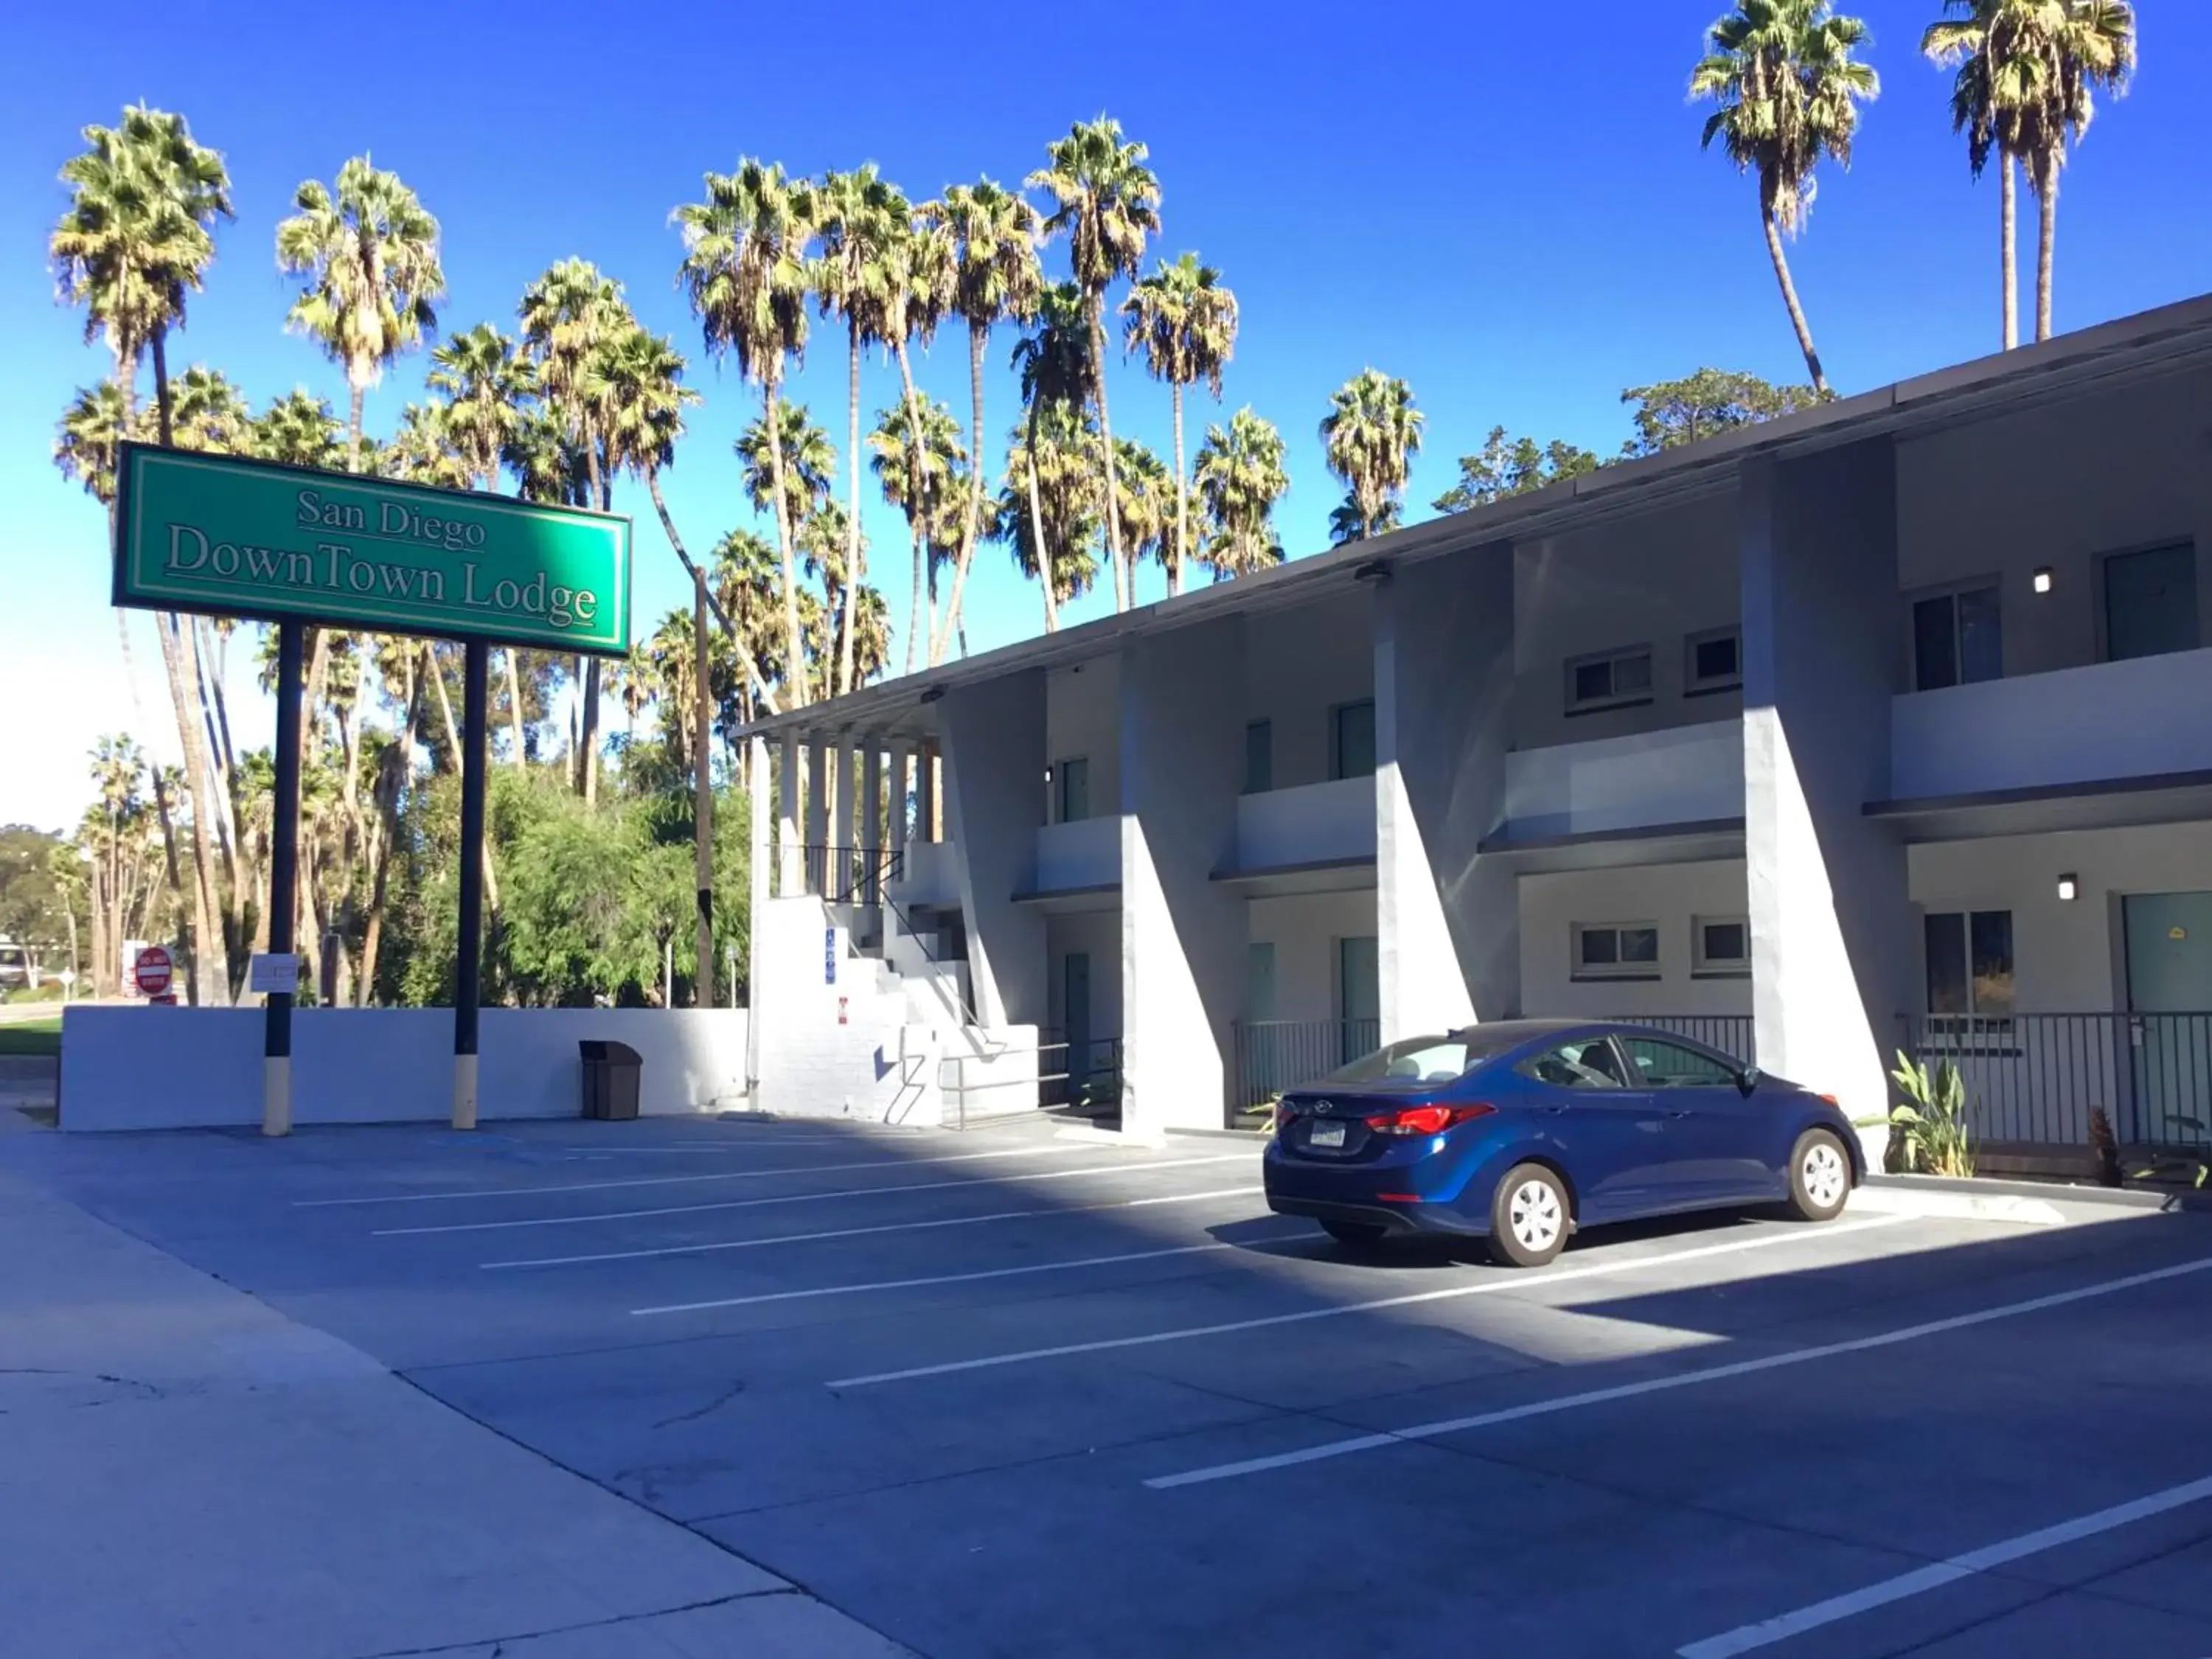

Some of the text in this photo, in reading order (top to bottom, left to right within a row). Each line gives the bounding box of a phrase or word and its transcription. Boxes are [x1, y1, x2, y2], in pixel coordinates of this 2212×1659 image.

[298, 490, 486, 551] San Diego
[463, 563, 597, 627] Lodge
